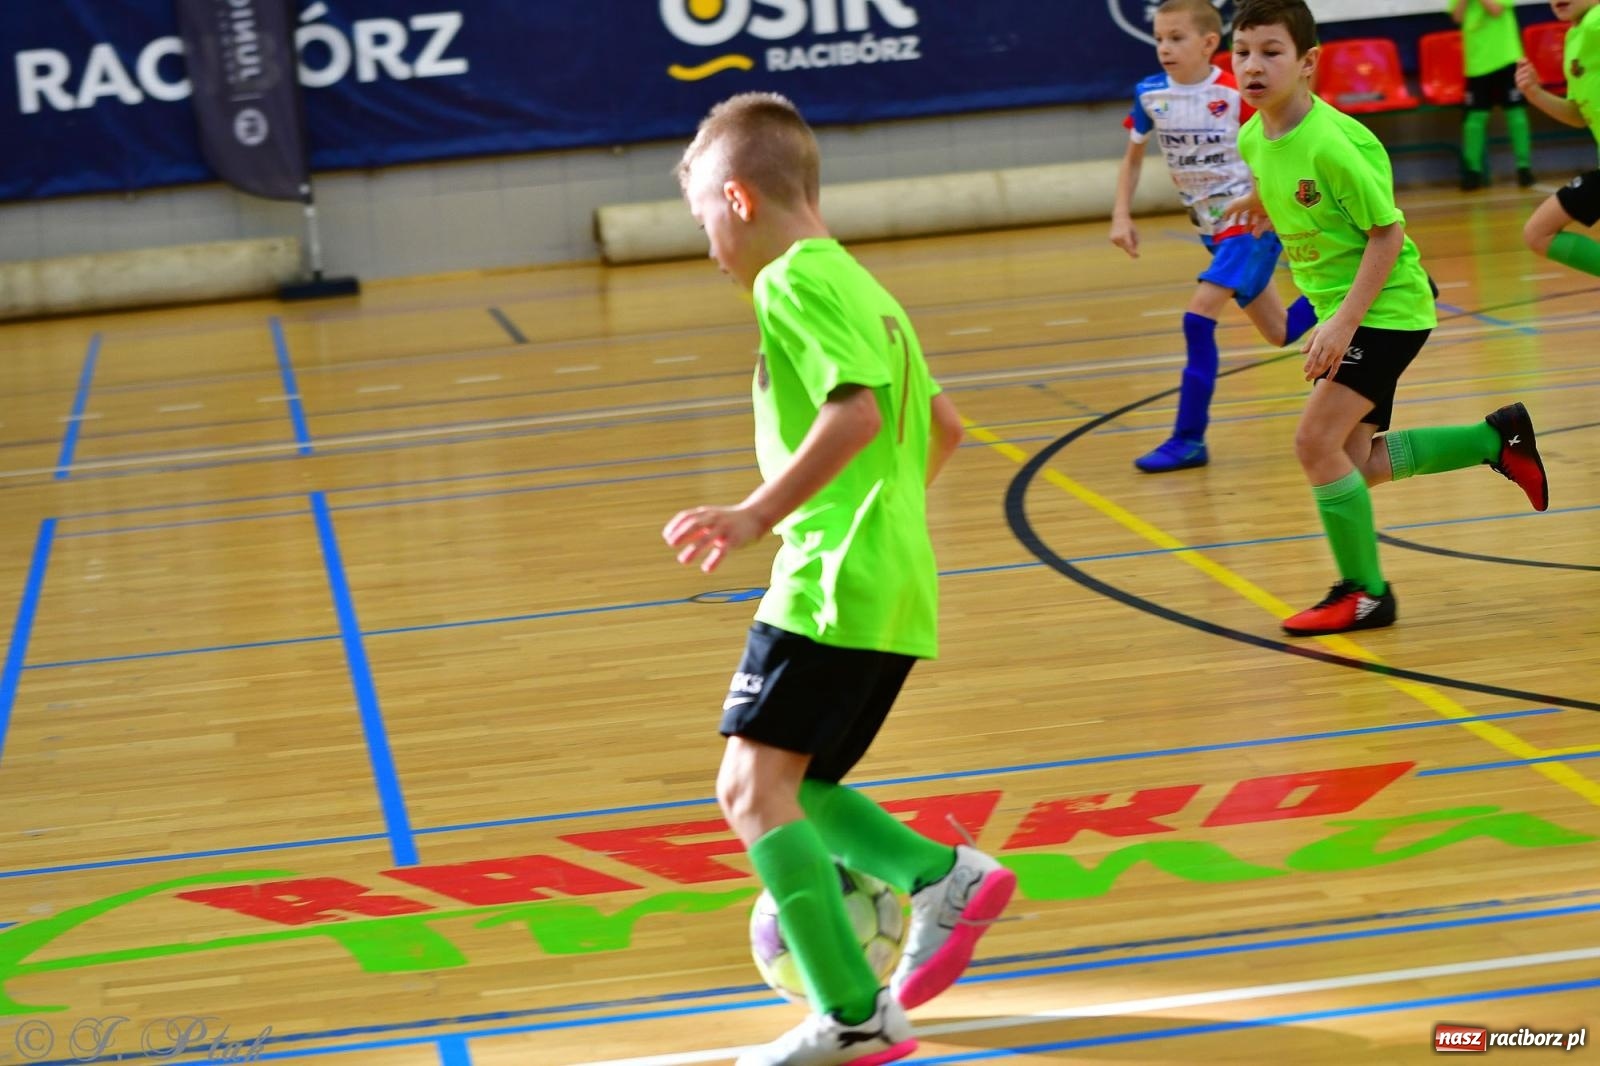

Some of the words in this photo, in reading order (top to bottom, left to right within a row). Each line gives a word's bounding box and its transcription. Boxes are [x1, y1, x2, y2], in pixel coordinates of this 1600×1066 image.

[15, 2, 469, 115] RACÓRZ
[765, 33, 922, 72] RACIBÓRZ
[880, 315, 912, 446] 7
